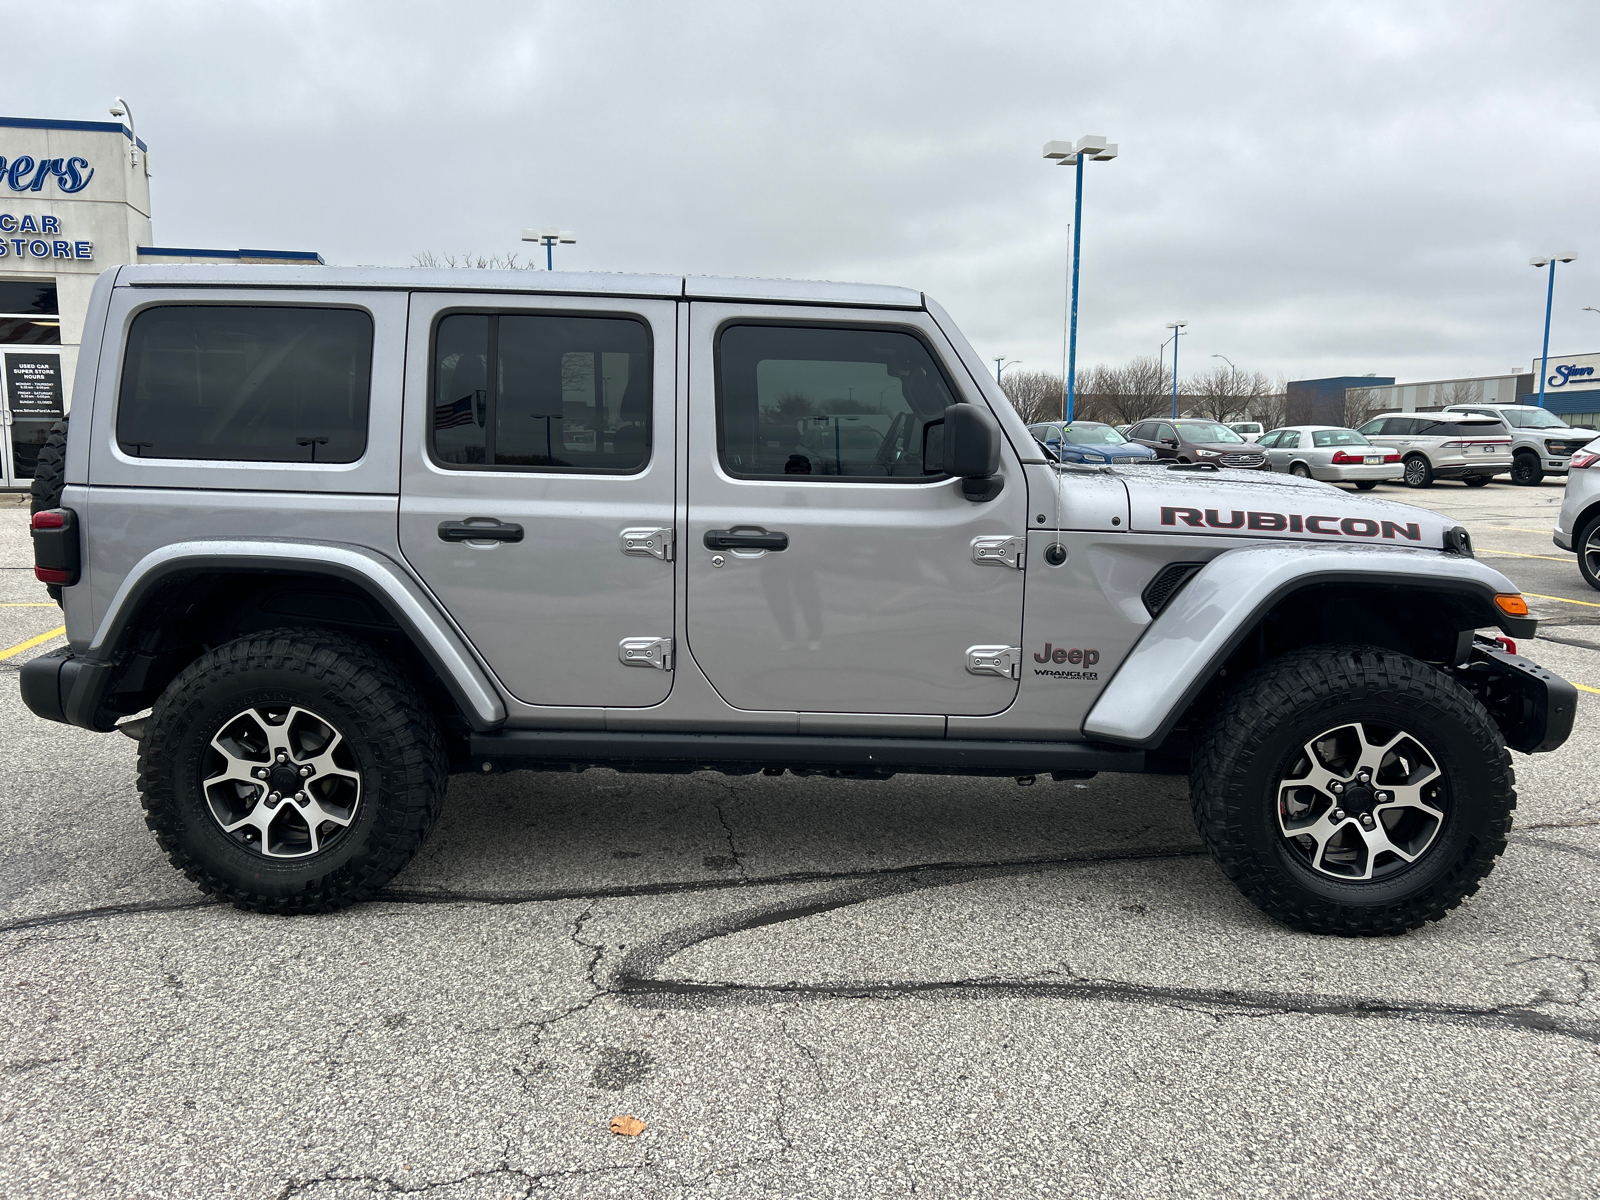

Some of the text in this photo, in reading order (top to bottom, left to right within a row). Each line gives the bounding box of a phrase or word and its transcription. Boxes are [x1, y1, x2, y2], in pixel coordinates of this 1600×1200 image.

[0, 213, 61, 234] CAR
[1160, 506, 1422, 541] RUBICON
[1033, 642, 1100, 669] Jeep
[1033, 669, 1098, 678] WRANGLER
